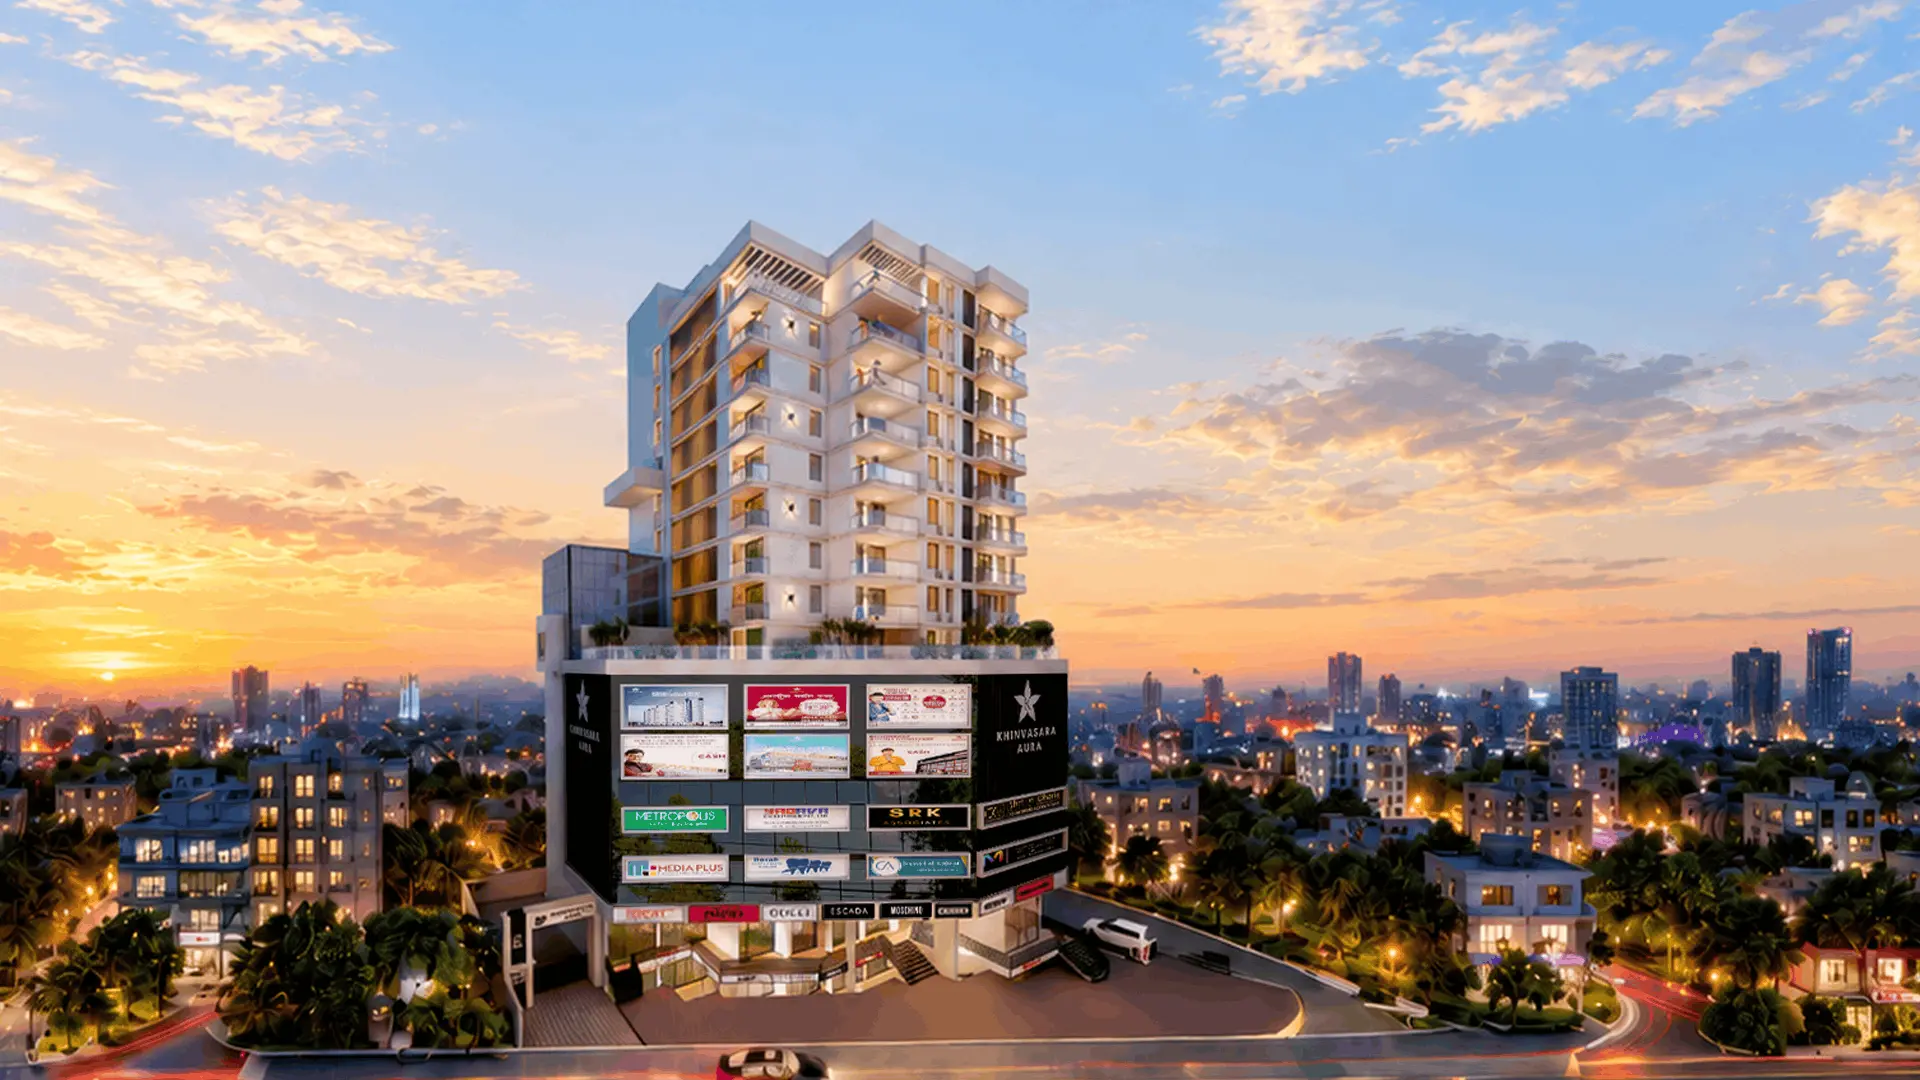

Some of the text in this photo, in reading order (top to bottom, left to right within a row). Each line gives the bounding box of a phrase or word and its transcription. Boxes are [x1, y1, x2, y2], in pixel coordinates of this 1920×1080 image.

[996, 726, 1057, 742] KHINVASARA
[1017, 741, 1043, 754] AURA
[889, 808, 941, 818] SRK
[658, 864, 723, 872] MEDIA PLUS
[830, 907, 869, 916] ESCADA
[890, 905, 924, 915] MOSCHINO
